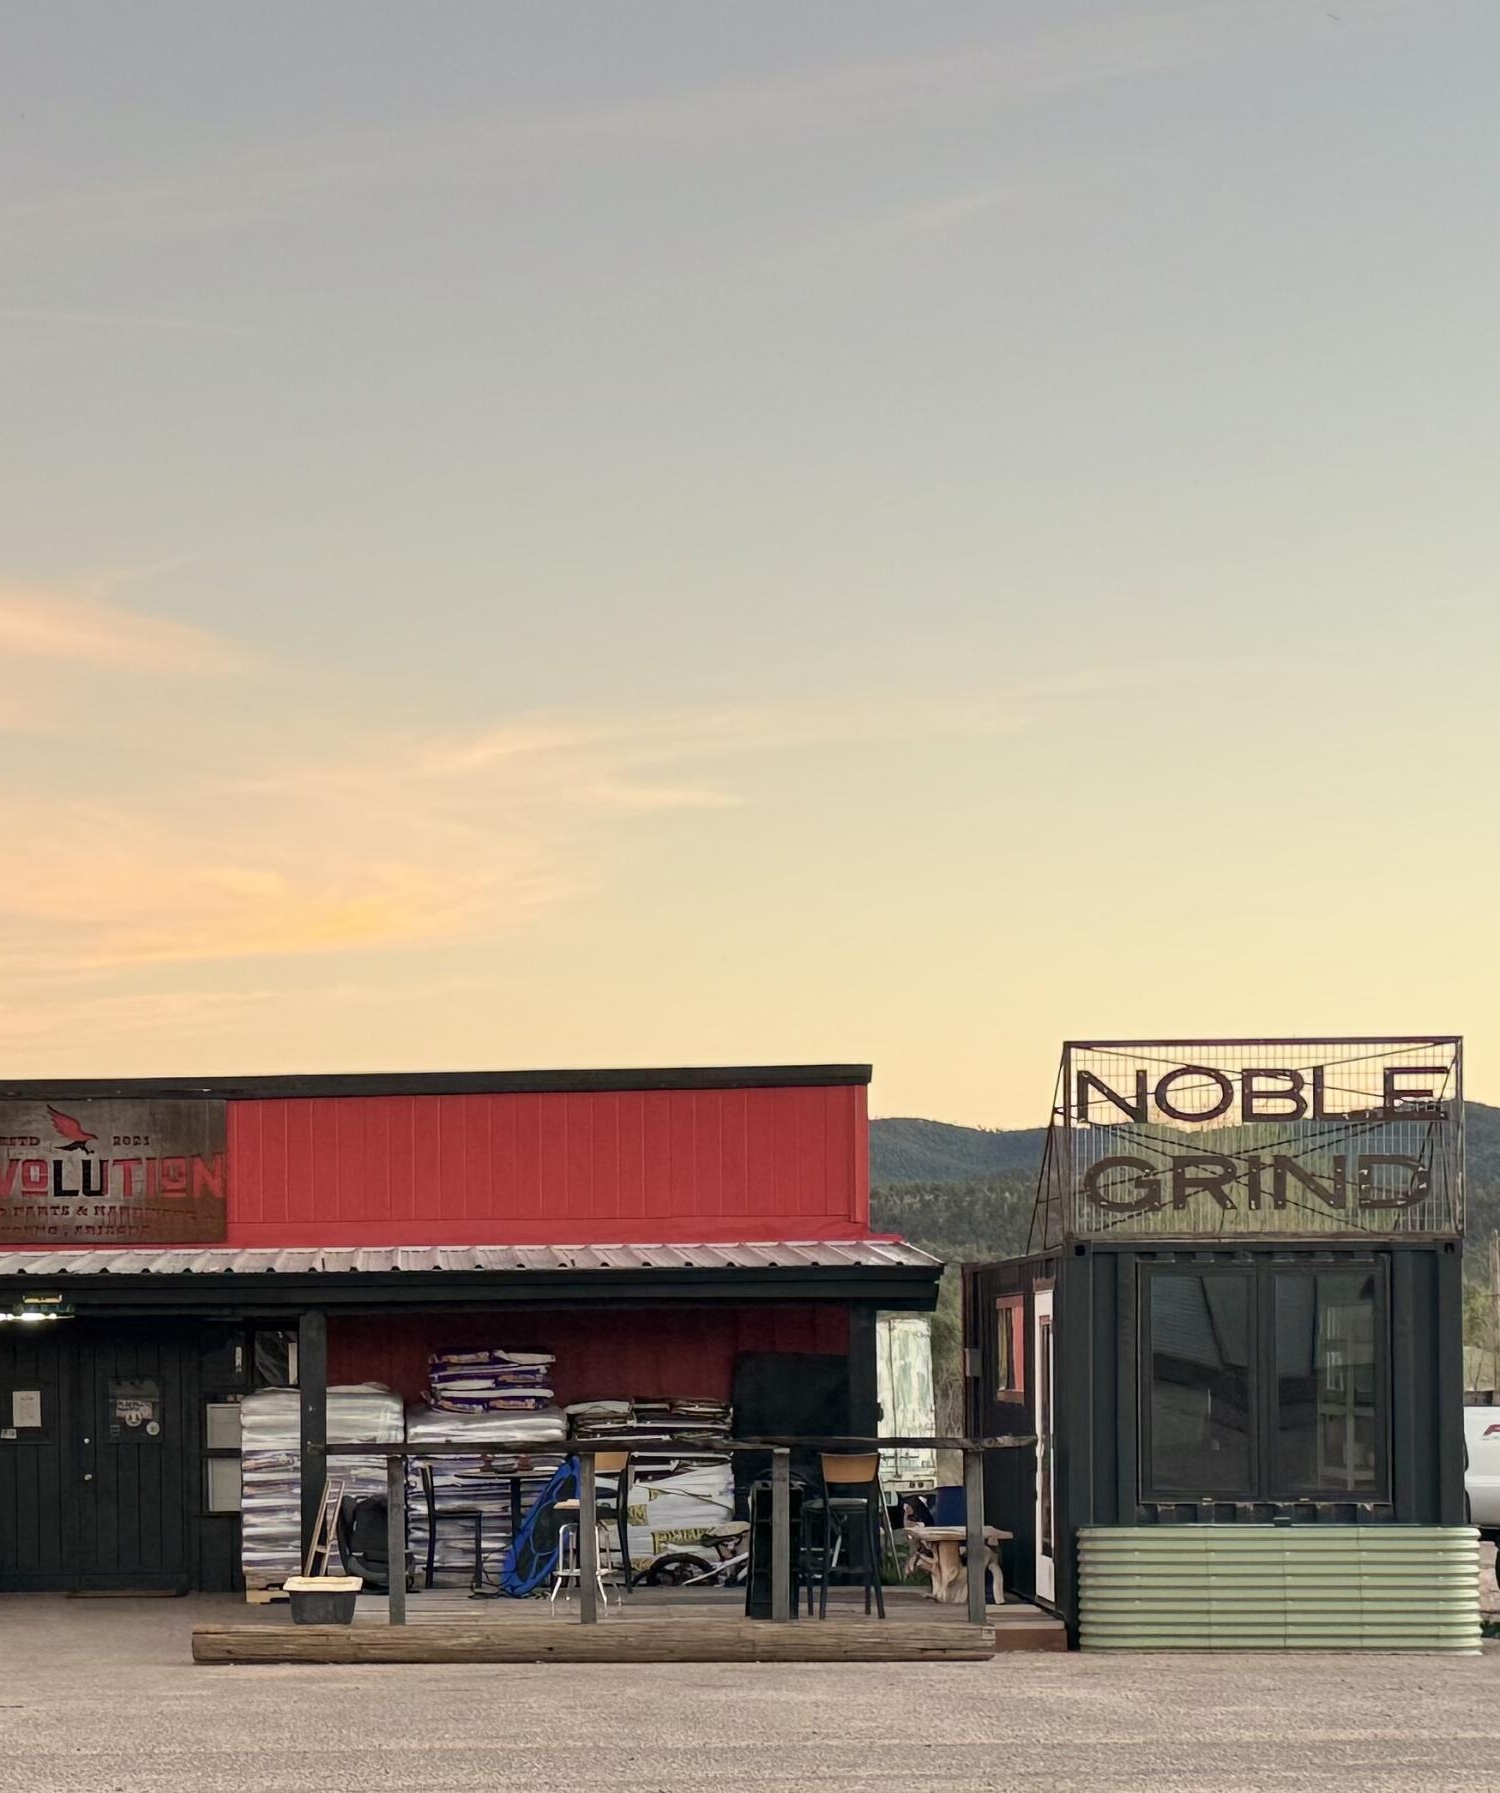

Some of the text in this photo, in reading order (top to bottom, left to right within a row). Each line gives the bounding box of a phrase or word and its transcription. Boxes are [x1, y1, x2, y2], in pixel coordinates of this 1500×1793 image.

[1076, 1065, 1450, 1123] NOBLE
[112, 1136, 150, 1147] 2021
[1083, 1154, 1431, 1213] GRIND
